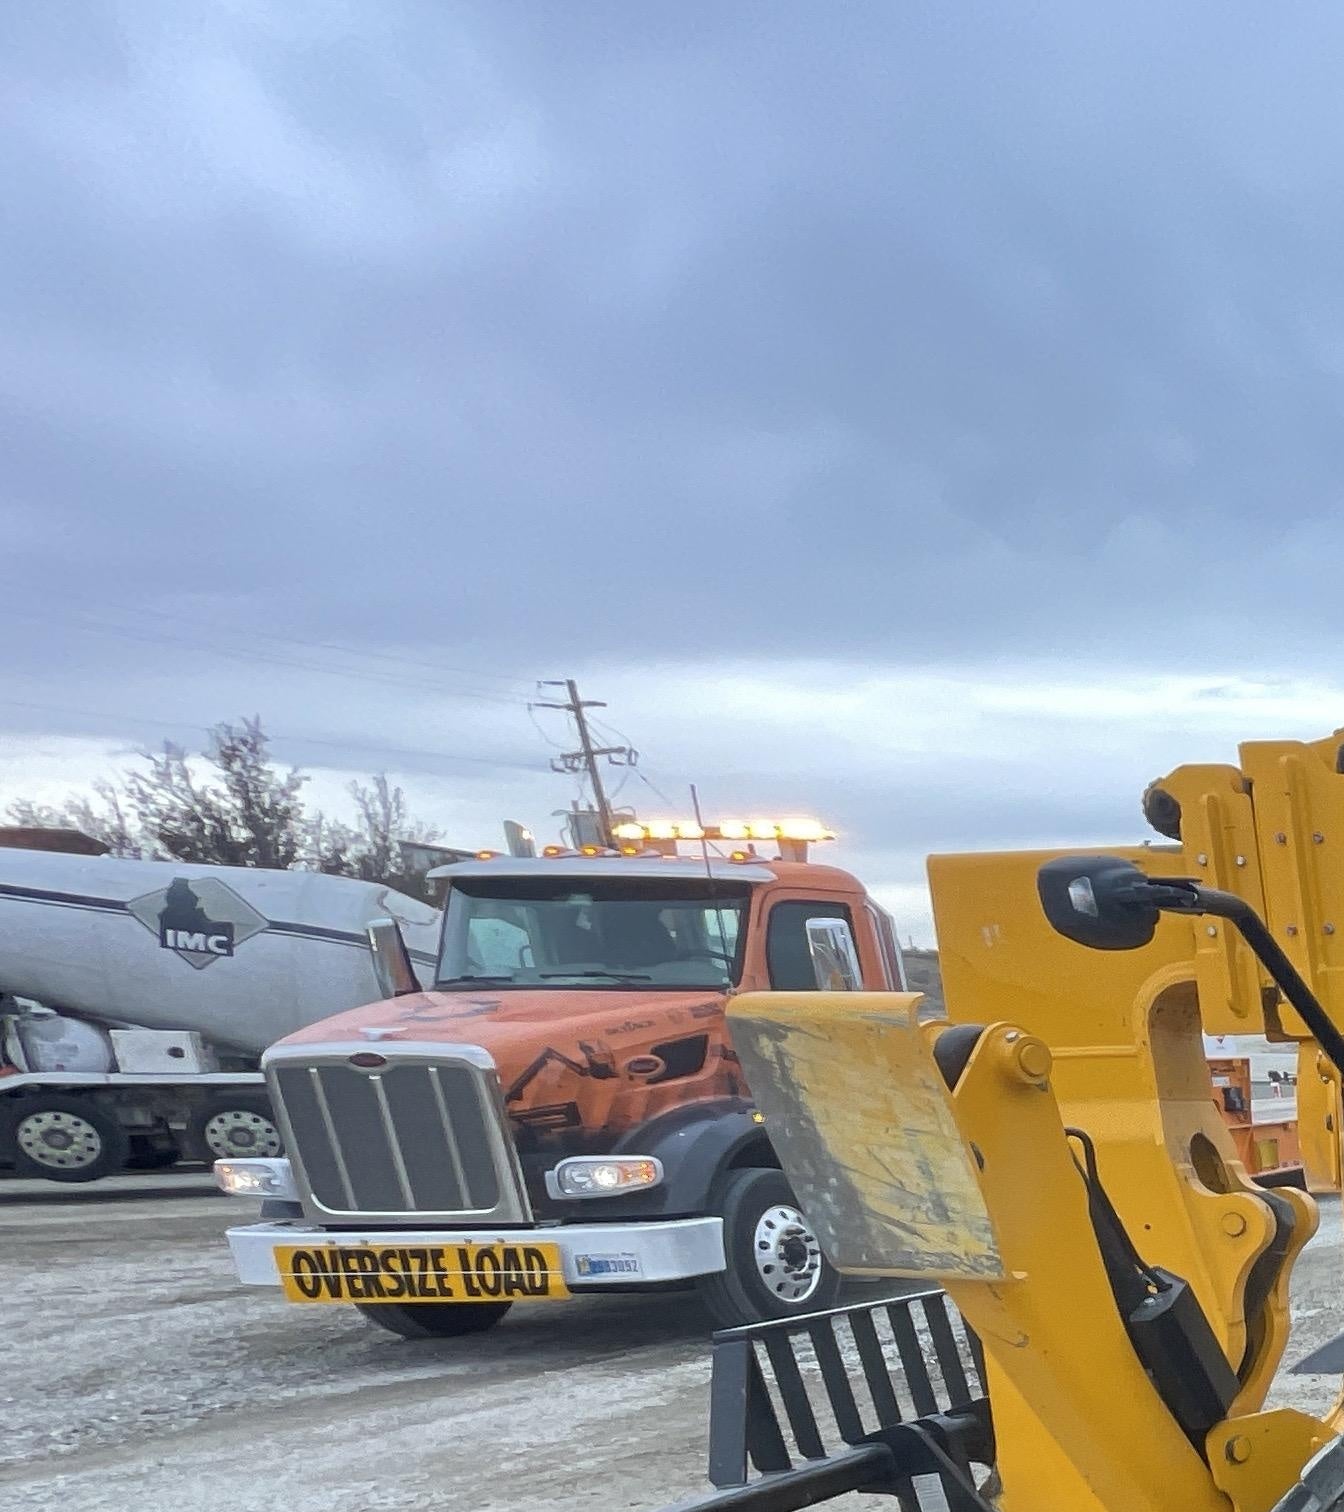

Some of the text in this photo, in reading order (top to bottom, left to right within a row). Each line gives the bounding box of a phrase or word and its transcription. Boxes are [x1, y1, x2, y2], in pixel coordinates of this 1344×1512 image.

[166, 929, 229, 954] IMC
[291, 1246, 549, 1298] OVERSIZE LOAD
